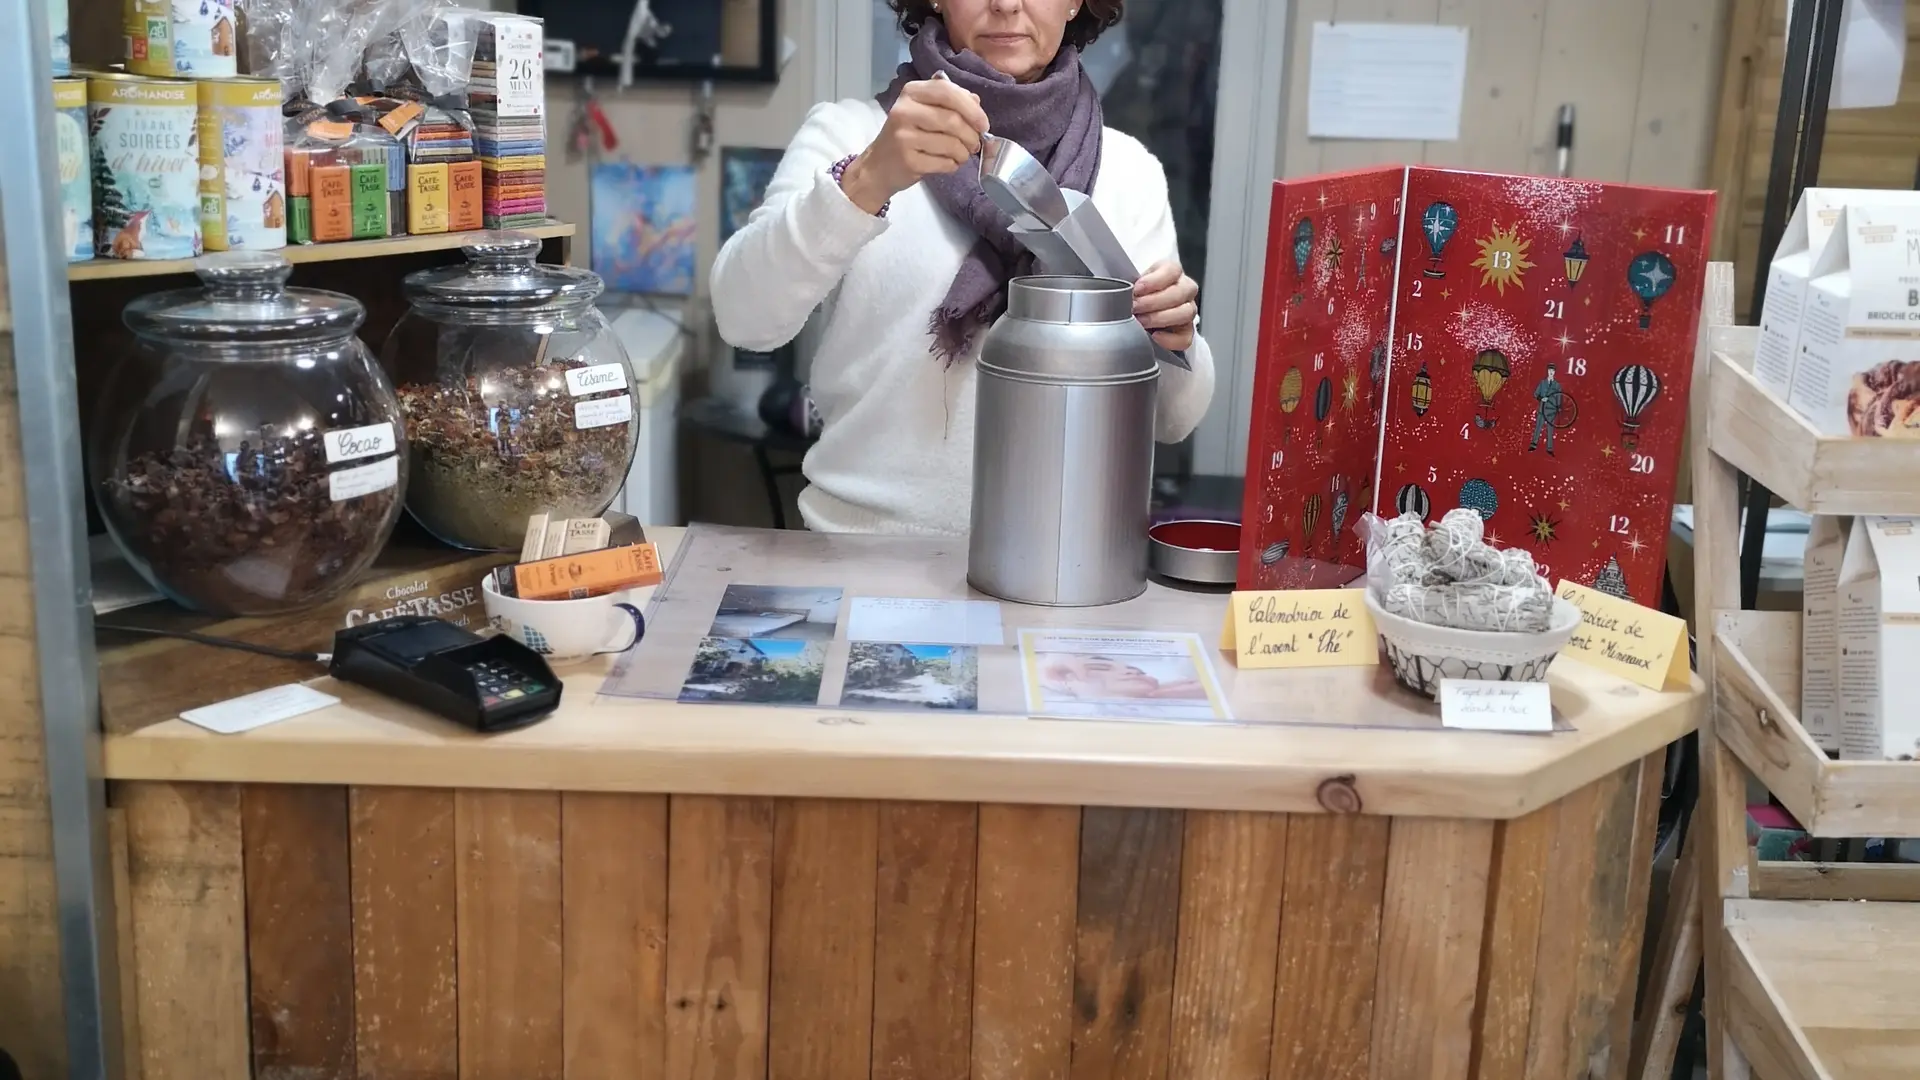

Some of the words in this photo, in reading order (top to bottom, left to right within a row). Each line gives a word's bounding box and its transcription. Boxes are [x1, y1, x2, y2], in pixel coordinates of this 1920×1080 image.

[509, 58, 532, 80] 26
[112, 87, 186, 100] AROMANDISE
[509, 81, 533, 91] MINI
[417, 183, 441, 194] TASSE
[454, 182, 476, 191] TASSE
[1370, 202, 1377, 220] 9
[1665, 225, 1686, 245] 11
[1492, 250, 1512, 270] 13
[1411, 279, 1423, 298] 2
[1327, 296, 1335, 316] 6
[1543, 300, 1564, 319] 21
[1281, 307, 1290, 328] 1
[1867, 311, 1906, 321] BRIOCHE
[1405, 332, 1423, 351] 15
[1313, 351, 1325, 372] 16
[1566, 357, 1587, 376] 18
[1459, 423, 1470, 440] 4
[1270, 450, 1284, 470] 19
[1629, 453, 1655, 475] 20
[1427, 466, 1438, 483] 5
[1266, 504, 1274, 523] 3
[568, 528, 597, 537] TASSE
[1609, 514, 1630, 535] 12
[386, 580, 429, 600] Chocolat
[1249, 596, 1325, 624] Calendrier
[1330, 602, 1352, 620] de
[1624, 620, 1646, 639] de
[1245, 632, 1300, 655] l'avent
